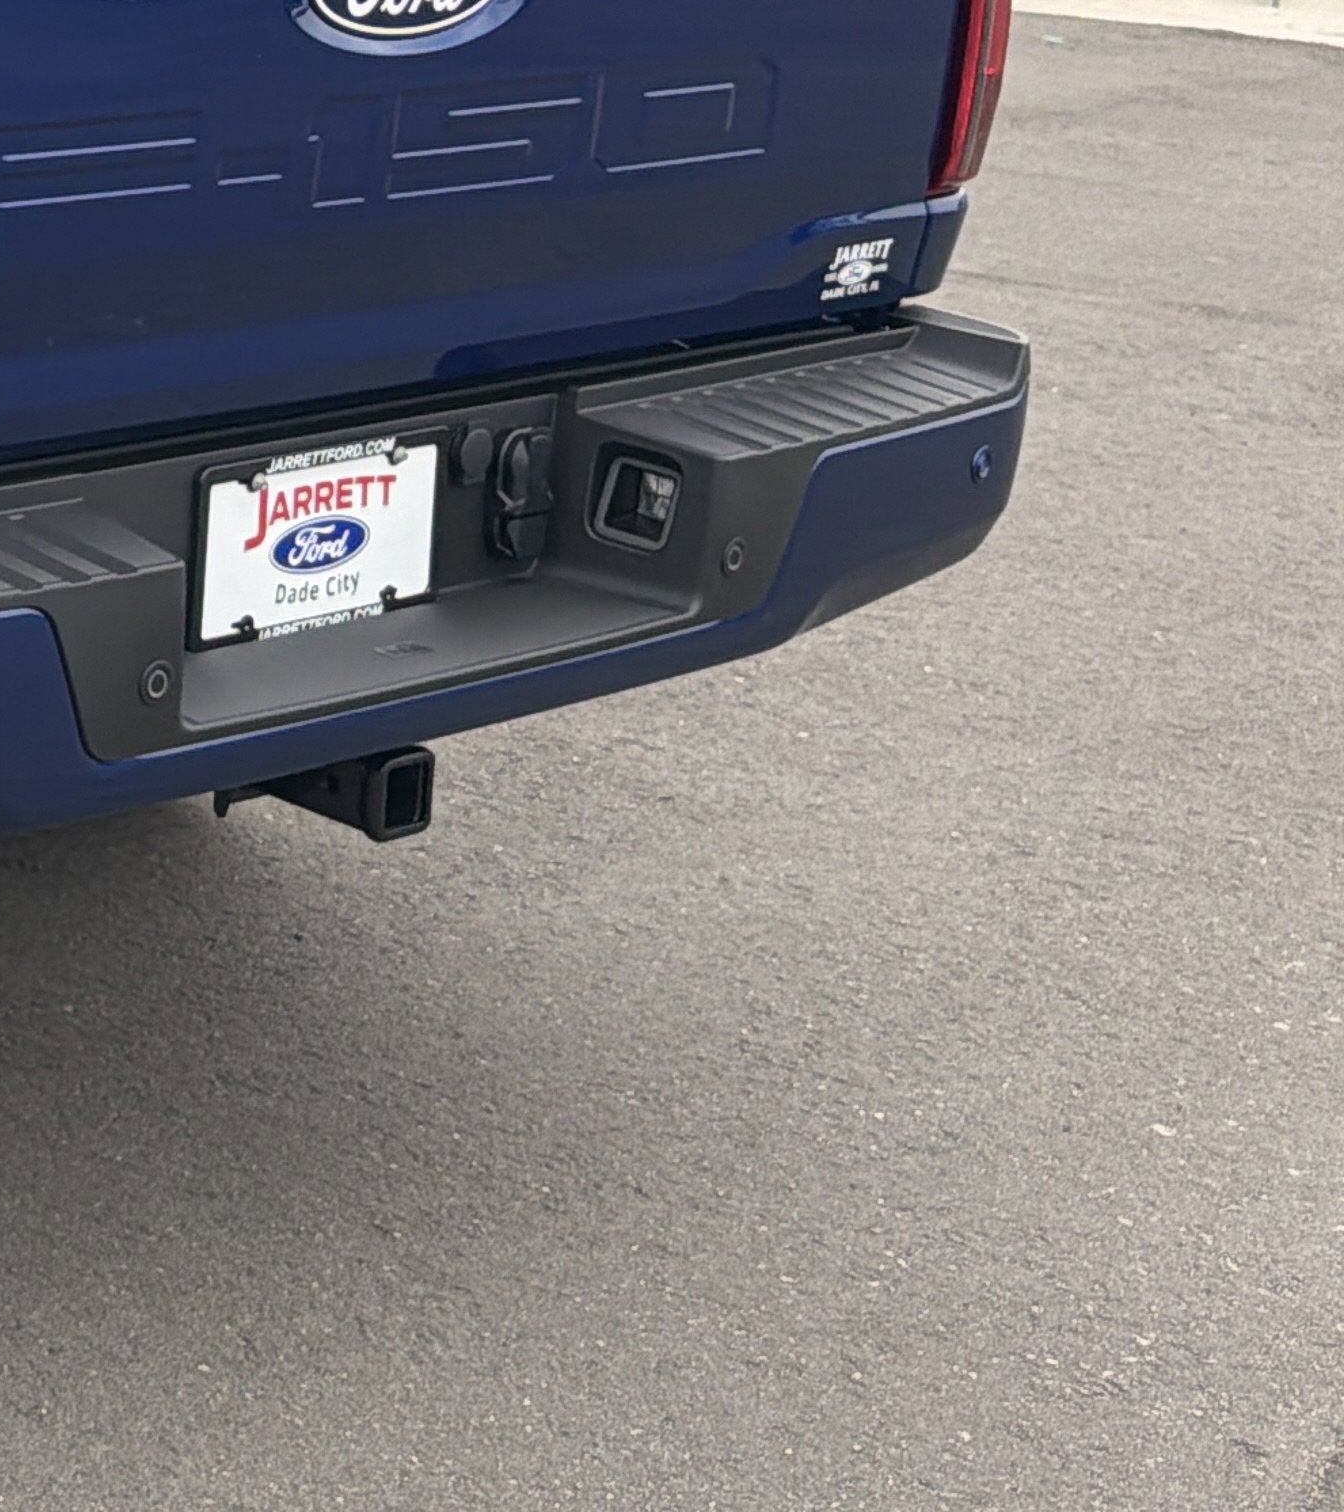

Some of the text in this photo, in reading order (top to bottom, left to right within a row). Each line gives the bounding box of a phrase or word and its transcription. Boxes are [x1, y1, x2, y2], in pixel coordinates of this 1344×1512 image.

[829, 238, 894, 271] JARRETT
[265, 436, 397, 474] JARRETTFORD.COM
[244, 475, 397, 552] JARRETT
[288, 523, 351, 567] Ford
[275, 571, 360, 604] Dade City
